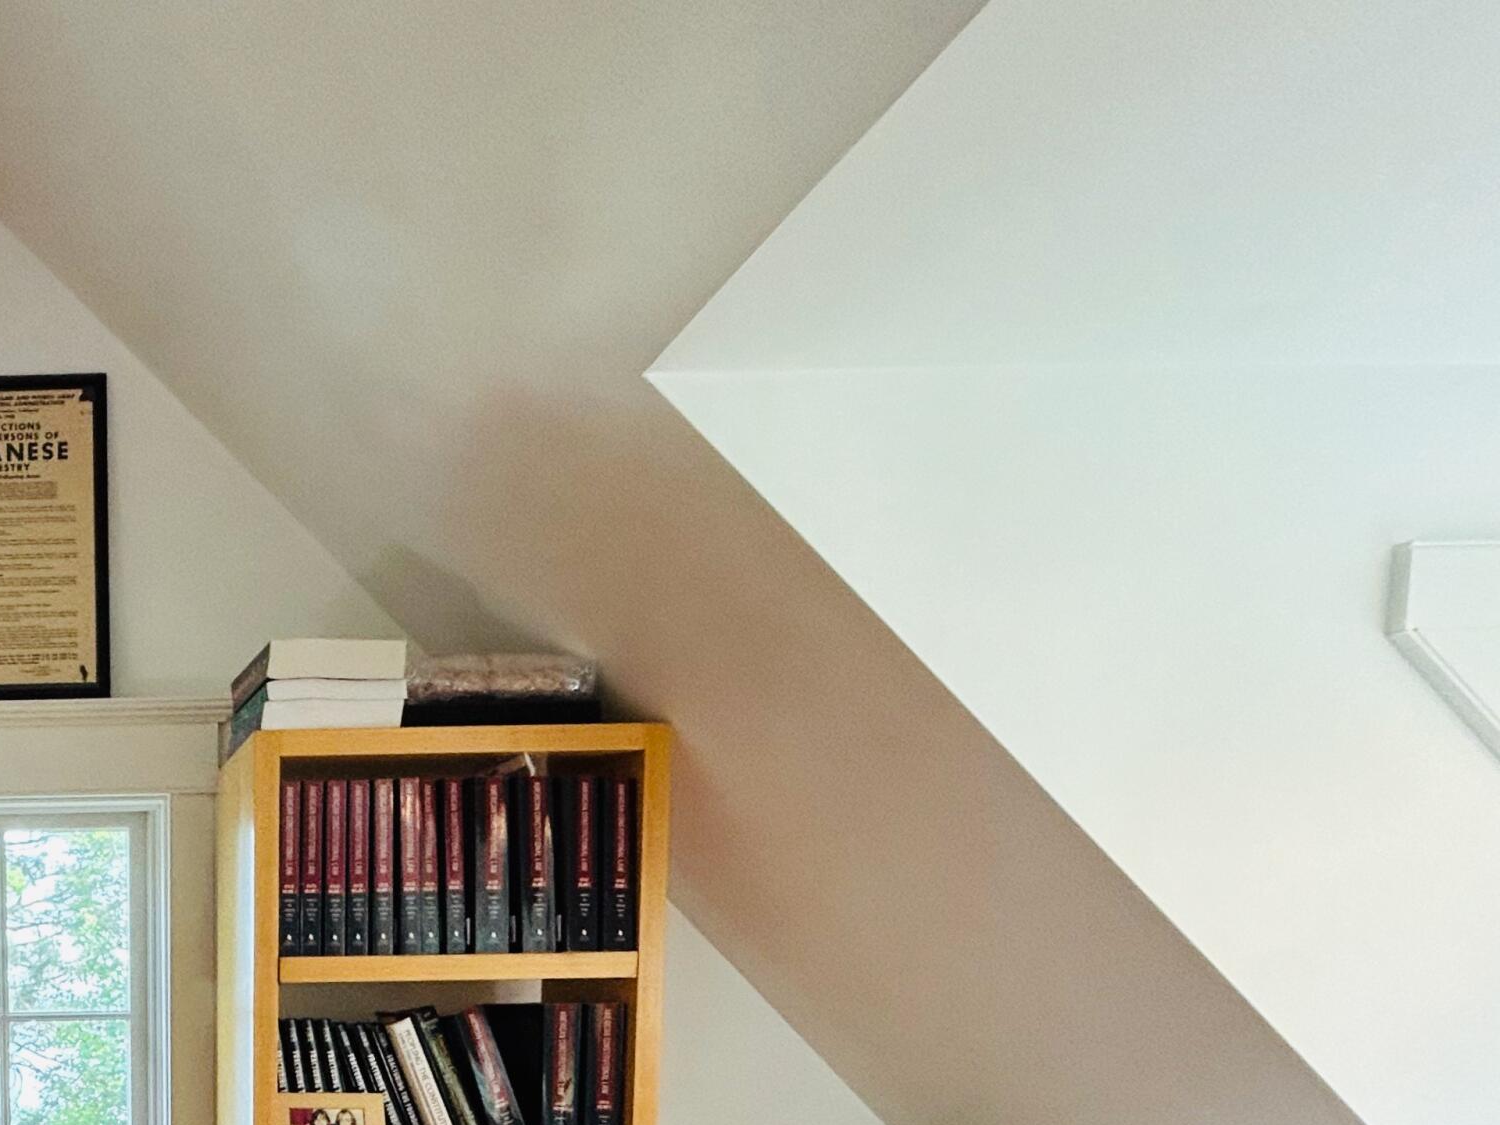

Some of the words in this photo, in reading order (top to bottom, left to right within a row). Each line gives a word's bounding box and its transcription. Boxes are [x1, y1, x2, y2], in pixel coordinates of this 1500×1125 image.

[45, 432, 59, 440] OF
[403, 1029, 423, 1066] PEOPLING
[418, 1067, 429, 1082] THE
